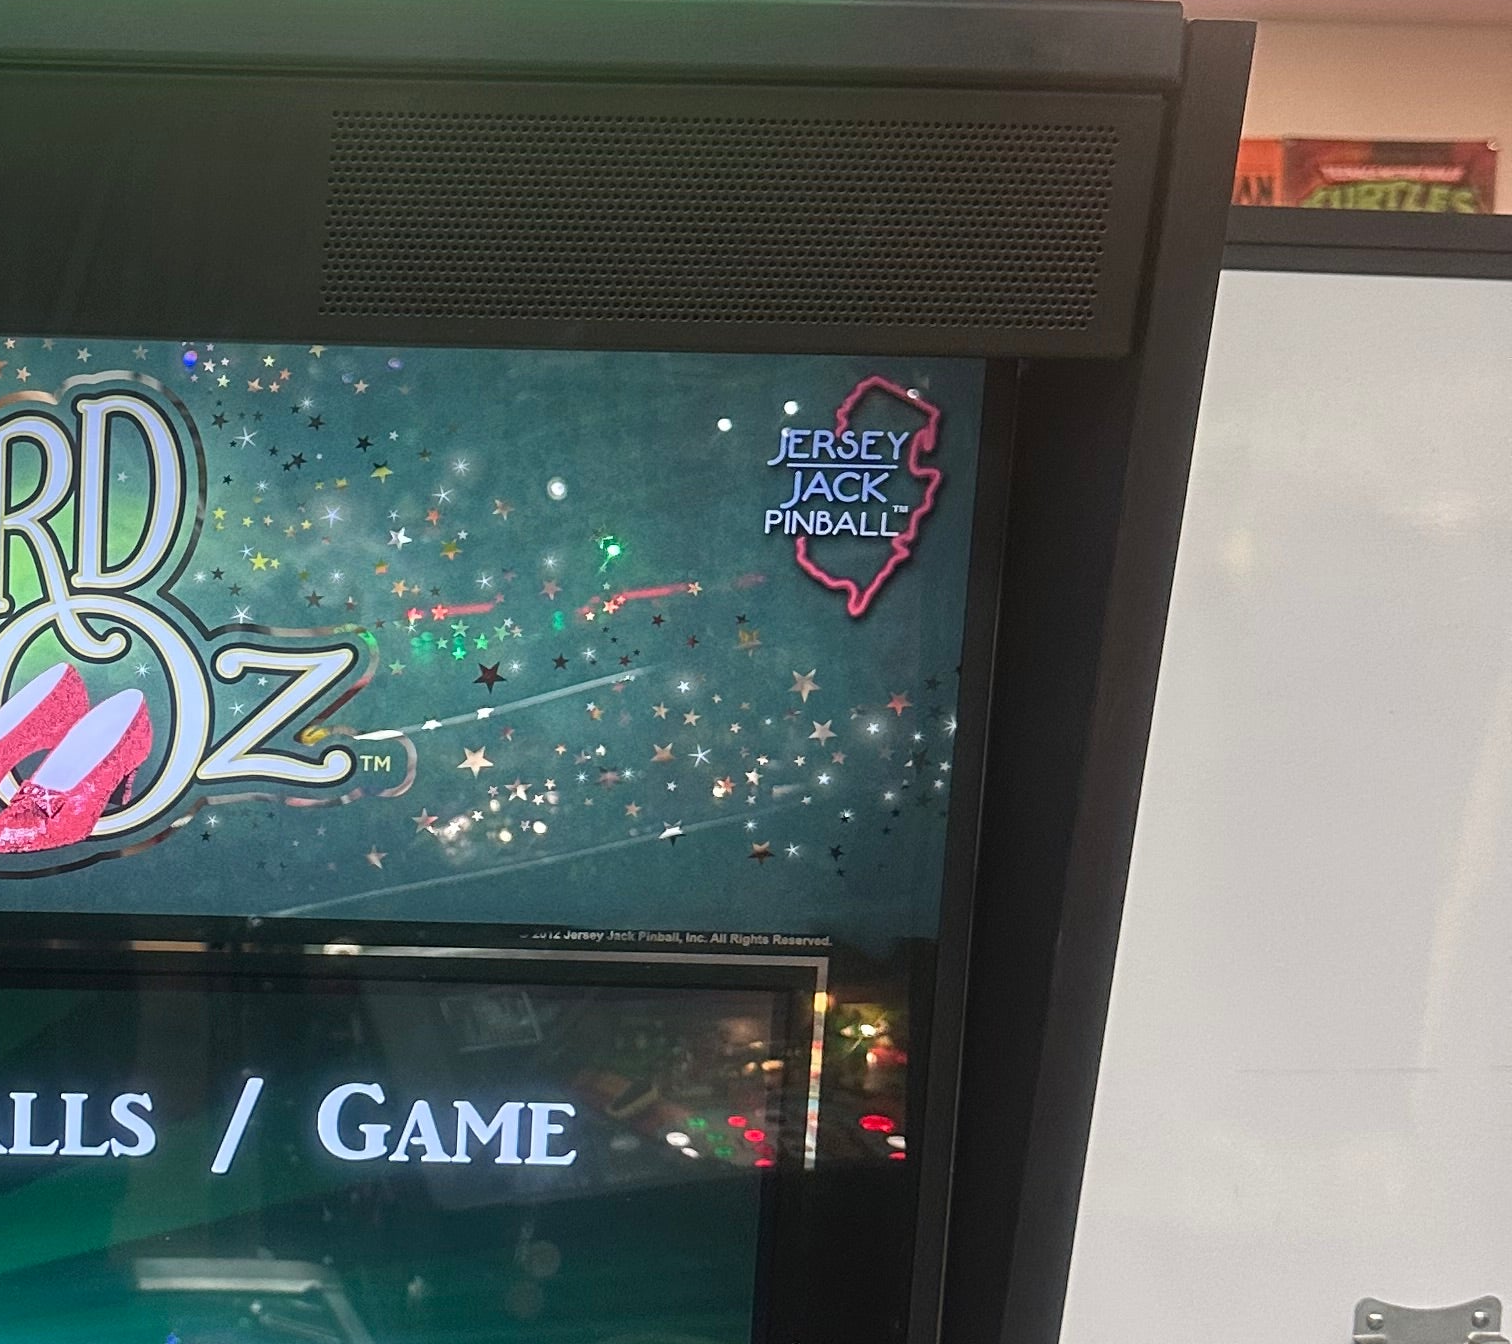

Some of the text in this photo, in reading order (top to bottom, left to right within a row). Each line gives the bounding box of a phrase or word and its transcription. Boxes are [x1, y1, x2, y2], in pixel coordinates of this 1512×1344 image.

[767, 428, 910, 467] JERSEY
[779, 470, 890, 510] JACK
[764, 509, 900, 537] PINBALL
[563, 929, 604, 943] Jersey
[606, 930, 635, 942] Jack
[709, 933, 727, 944] All
[729, 933, 769, 947] Rights
[772, 934, 833, 947] Reserved.
[209, 1075, 264, 1175] /
